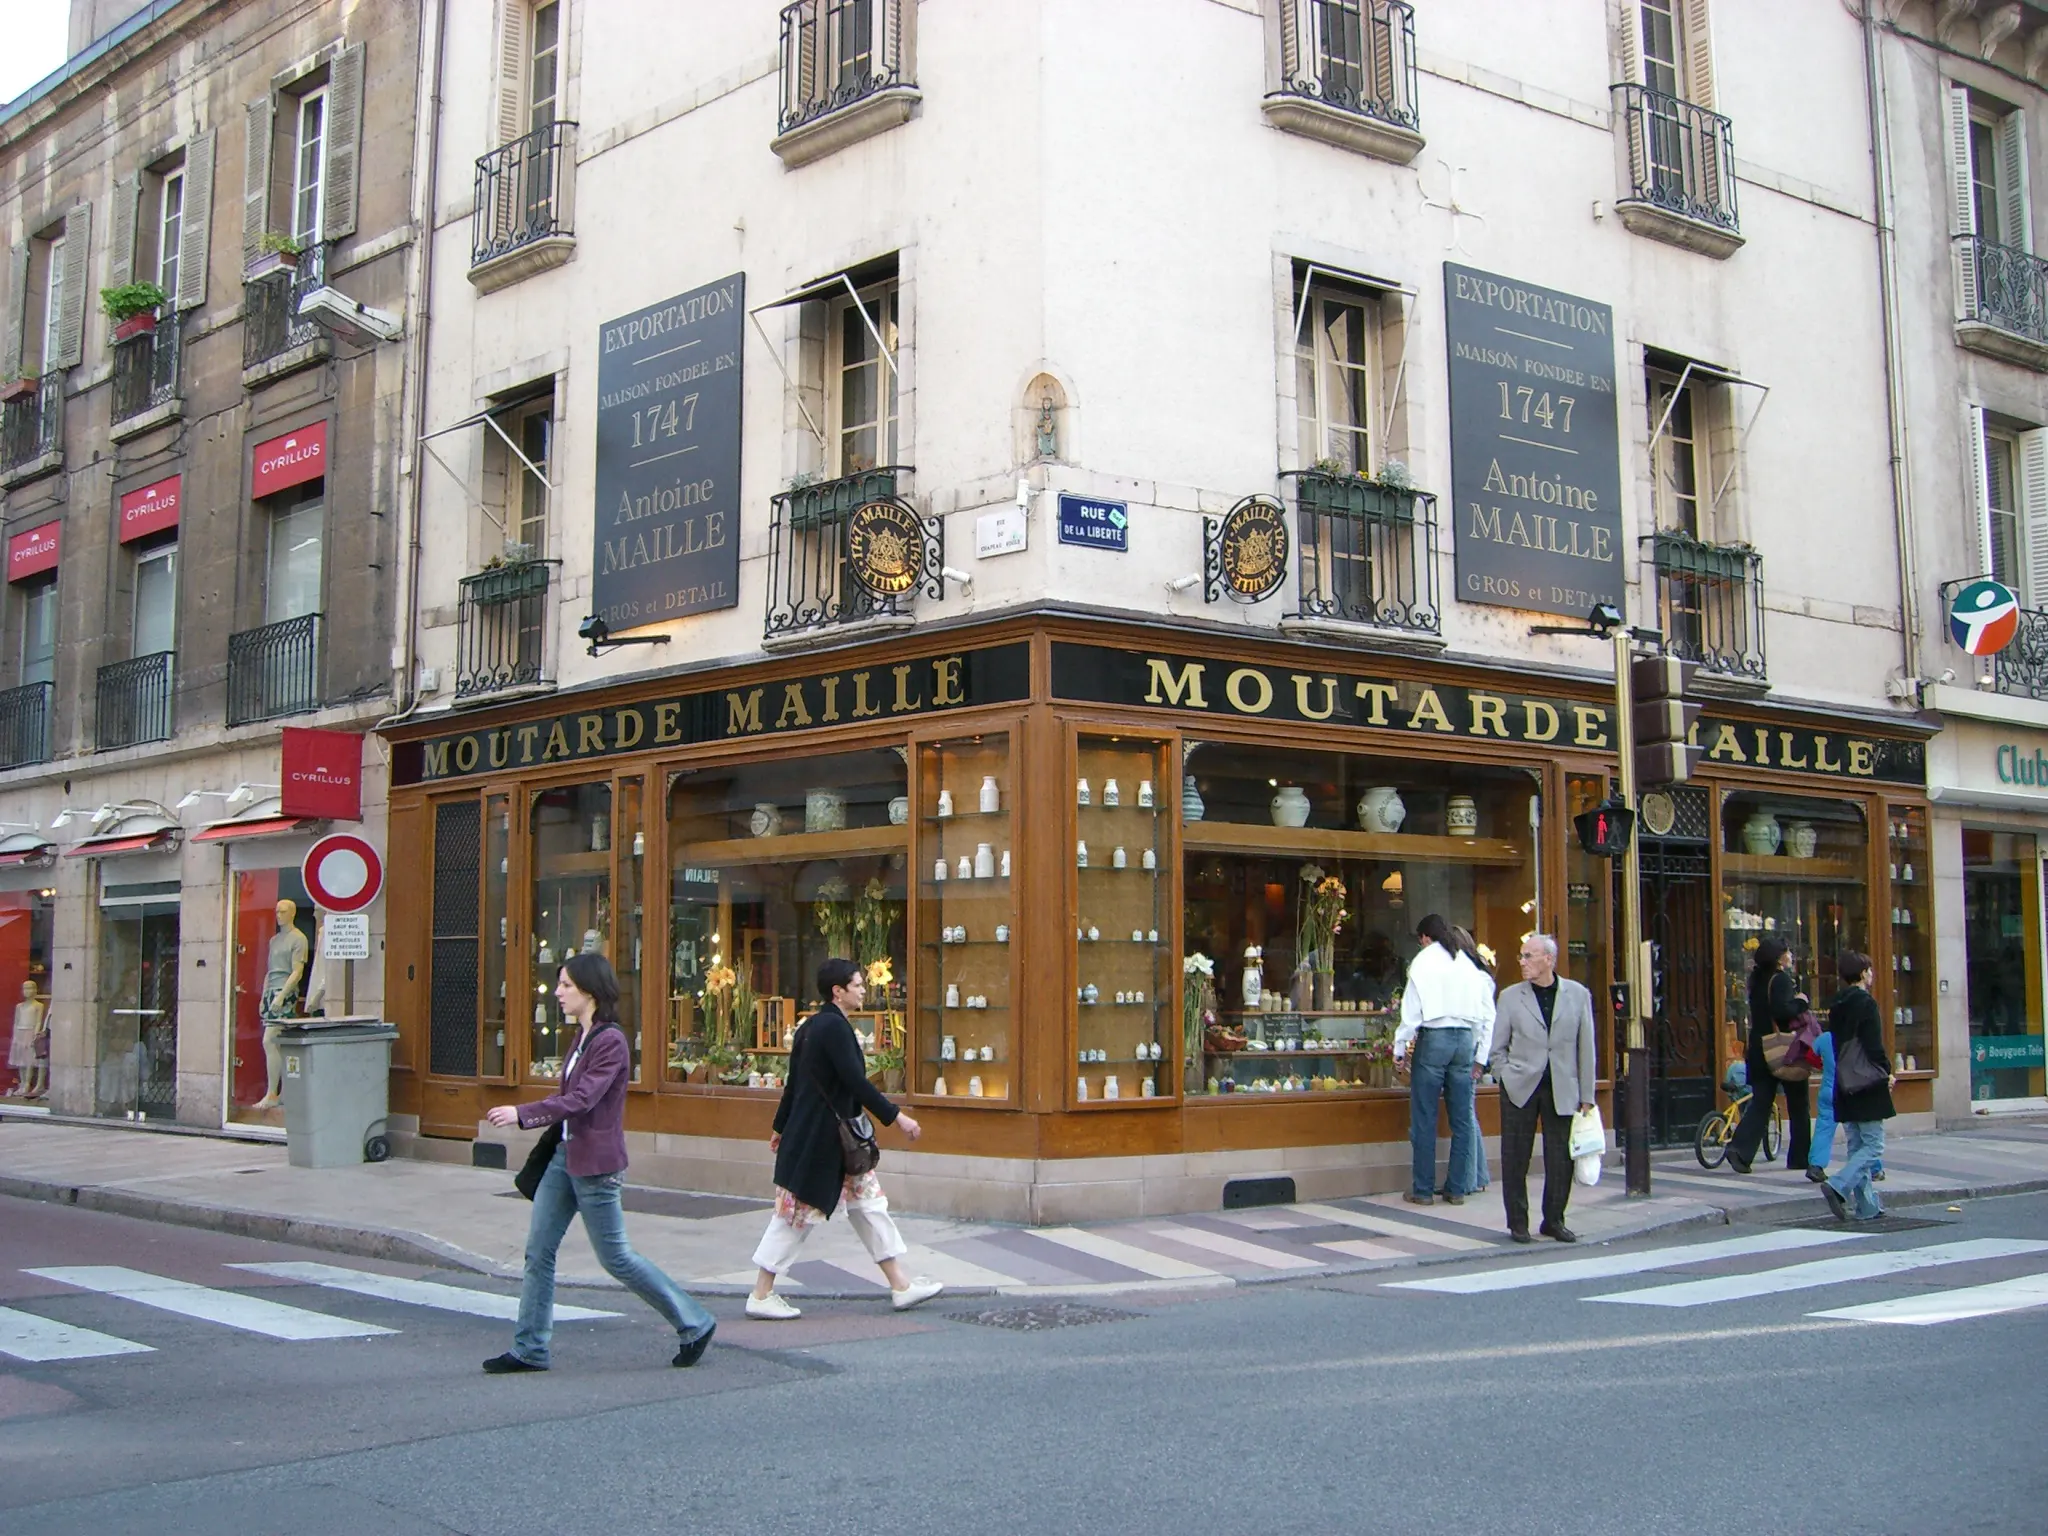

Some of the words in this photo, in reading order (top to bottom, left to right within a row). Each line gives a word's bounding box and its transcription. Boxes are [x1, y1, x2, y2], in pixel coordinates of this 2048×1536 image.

[604, 284, 735, 354] EXPORTATION
[1455, 272, 1606, 336] EXPORTATION
[600, 380, 651, 411] MAISON
[655, 359, 710, 392] FONDEE
[715, 352, 735, 373] EN
[1456, 342, 1518, 370] MAISON
[1524, 359, 1585, 388] FONDEE
[1591, 375, 1611, 394] EN
[631, 392, 700, 449] 1747
[1497, 381, 1576, 433] 1747
[261, 443, 321, 475] CYRILLUS
[613, 476, 714, 526] Antoine
[1482, 457, 1598, 513] Antoine
[126, 494, 176, 521] CYRILLUS
[861, 506, 912, 532] MAILLE
[1080, 505, 1106, 520] RUE
[1231, 506, 1275, 533] MAILLE
[602, 511, 726, 576] MAILLE
[850, 525, 864, 559] 1747
[1064, 524, 1074, 536] DE
[1075, 525, 1085, 536] LA
[1274, 525, 1286, 559] 1747
[1469, 502, 1614, 563] MAILLE
[14, 538, 56, 563] CYRILLUS
[909, 538, 922, 571] 1747
[1224, 539, 1235, 572] 1747
[861, 565, 913, 591] MAILLE
[1233, 564, 1278, 592] MAILLE
[1467, 572, 1521, 598] GROS
[1529, 587, 1542, 601] et
[599, 601, 639, 623] GROS
[646, 600, 657, 614] et
[665, 581, 727, 610] DETAIL
[422, 702, 682, 779] MOUTARDE
[726, 656, 965, 735] MAILLE
[1144, 658, 1608, 747] MOUTARDE
[292, 772, 351, 785] CYRILLUS
[1997, 744, 2048, 786] Club
[1989, 1045, 2026, 1060] Bouygues
